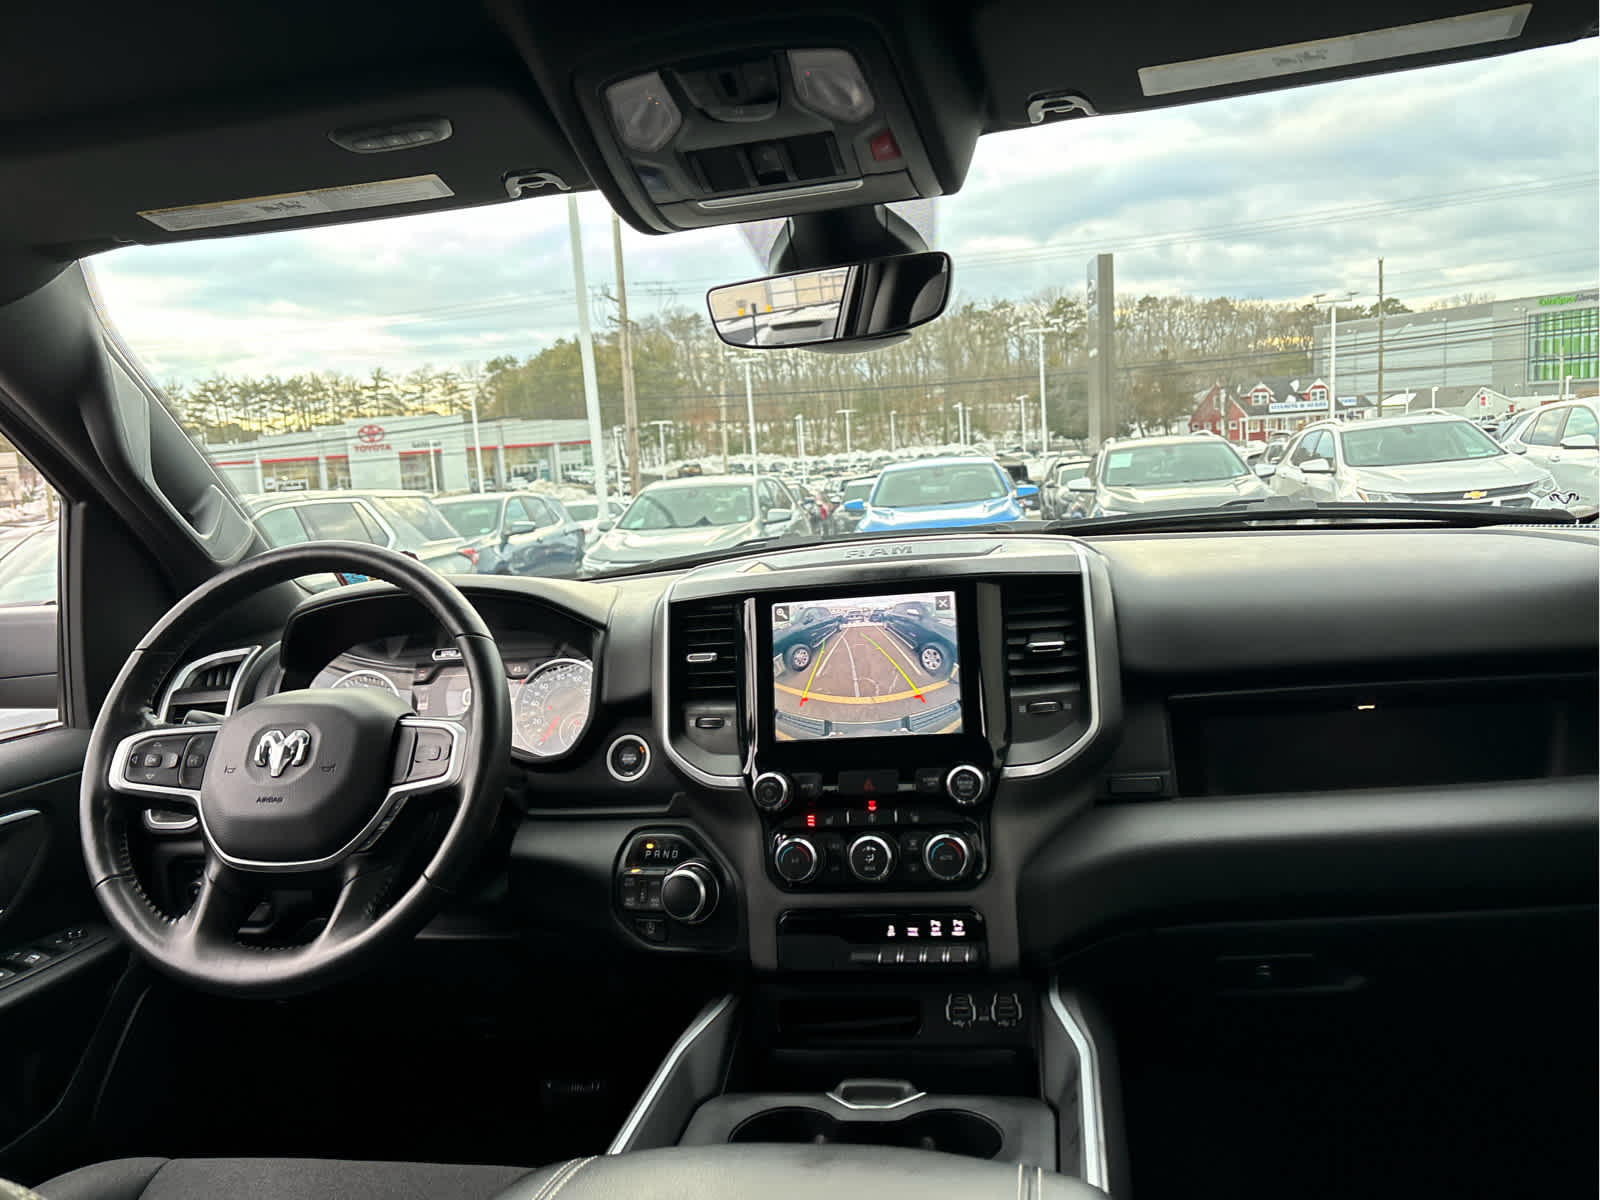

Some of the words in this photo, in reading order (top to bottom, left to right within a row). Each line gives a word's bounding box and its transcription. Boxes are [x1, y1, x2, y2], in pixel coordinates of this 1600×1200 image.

[354, 443, 392, 452] TOYOTA
[844, 545, 912, 559] RAM
[256, 796, 283, 804] AIRBAG
[645, 850, 652, 858] P
[663, 850, 670, 858] N
[671, 850, 679, 858] D
